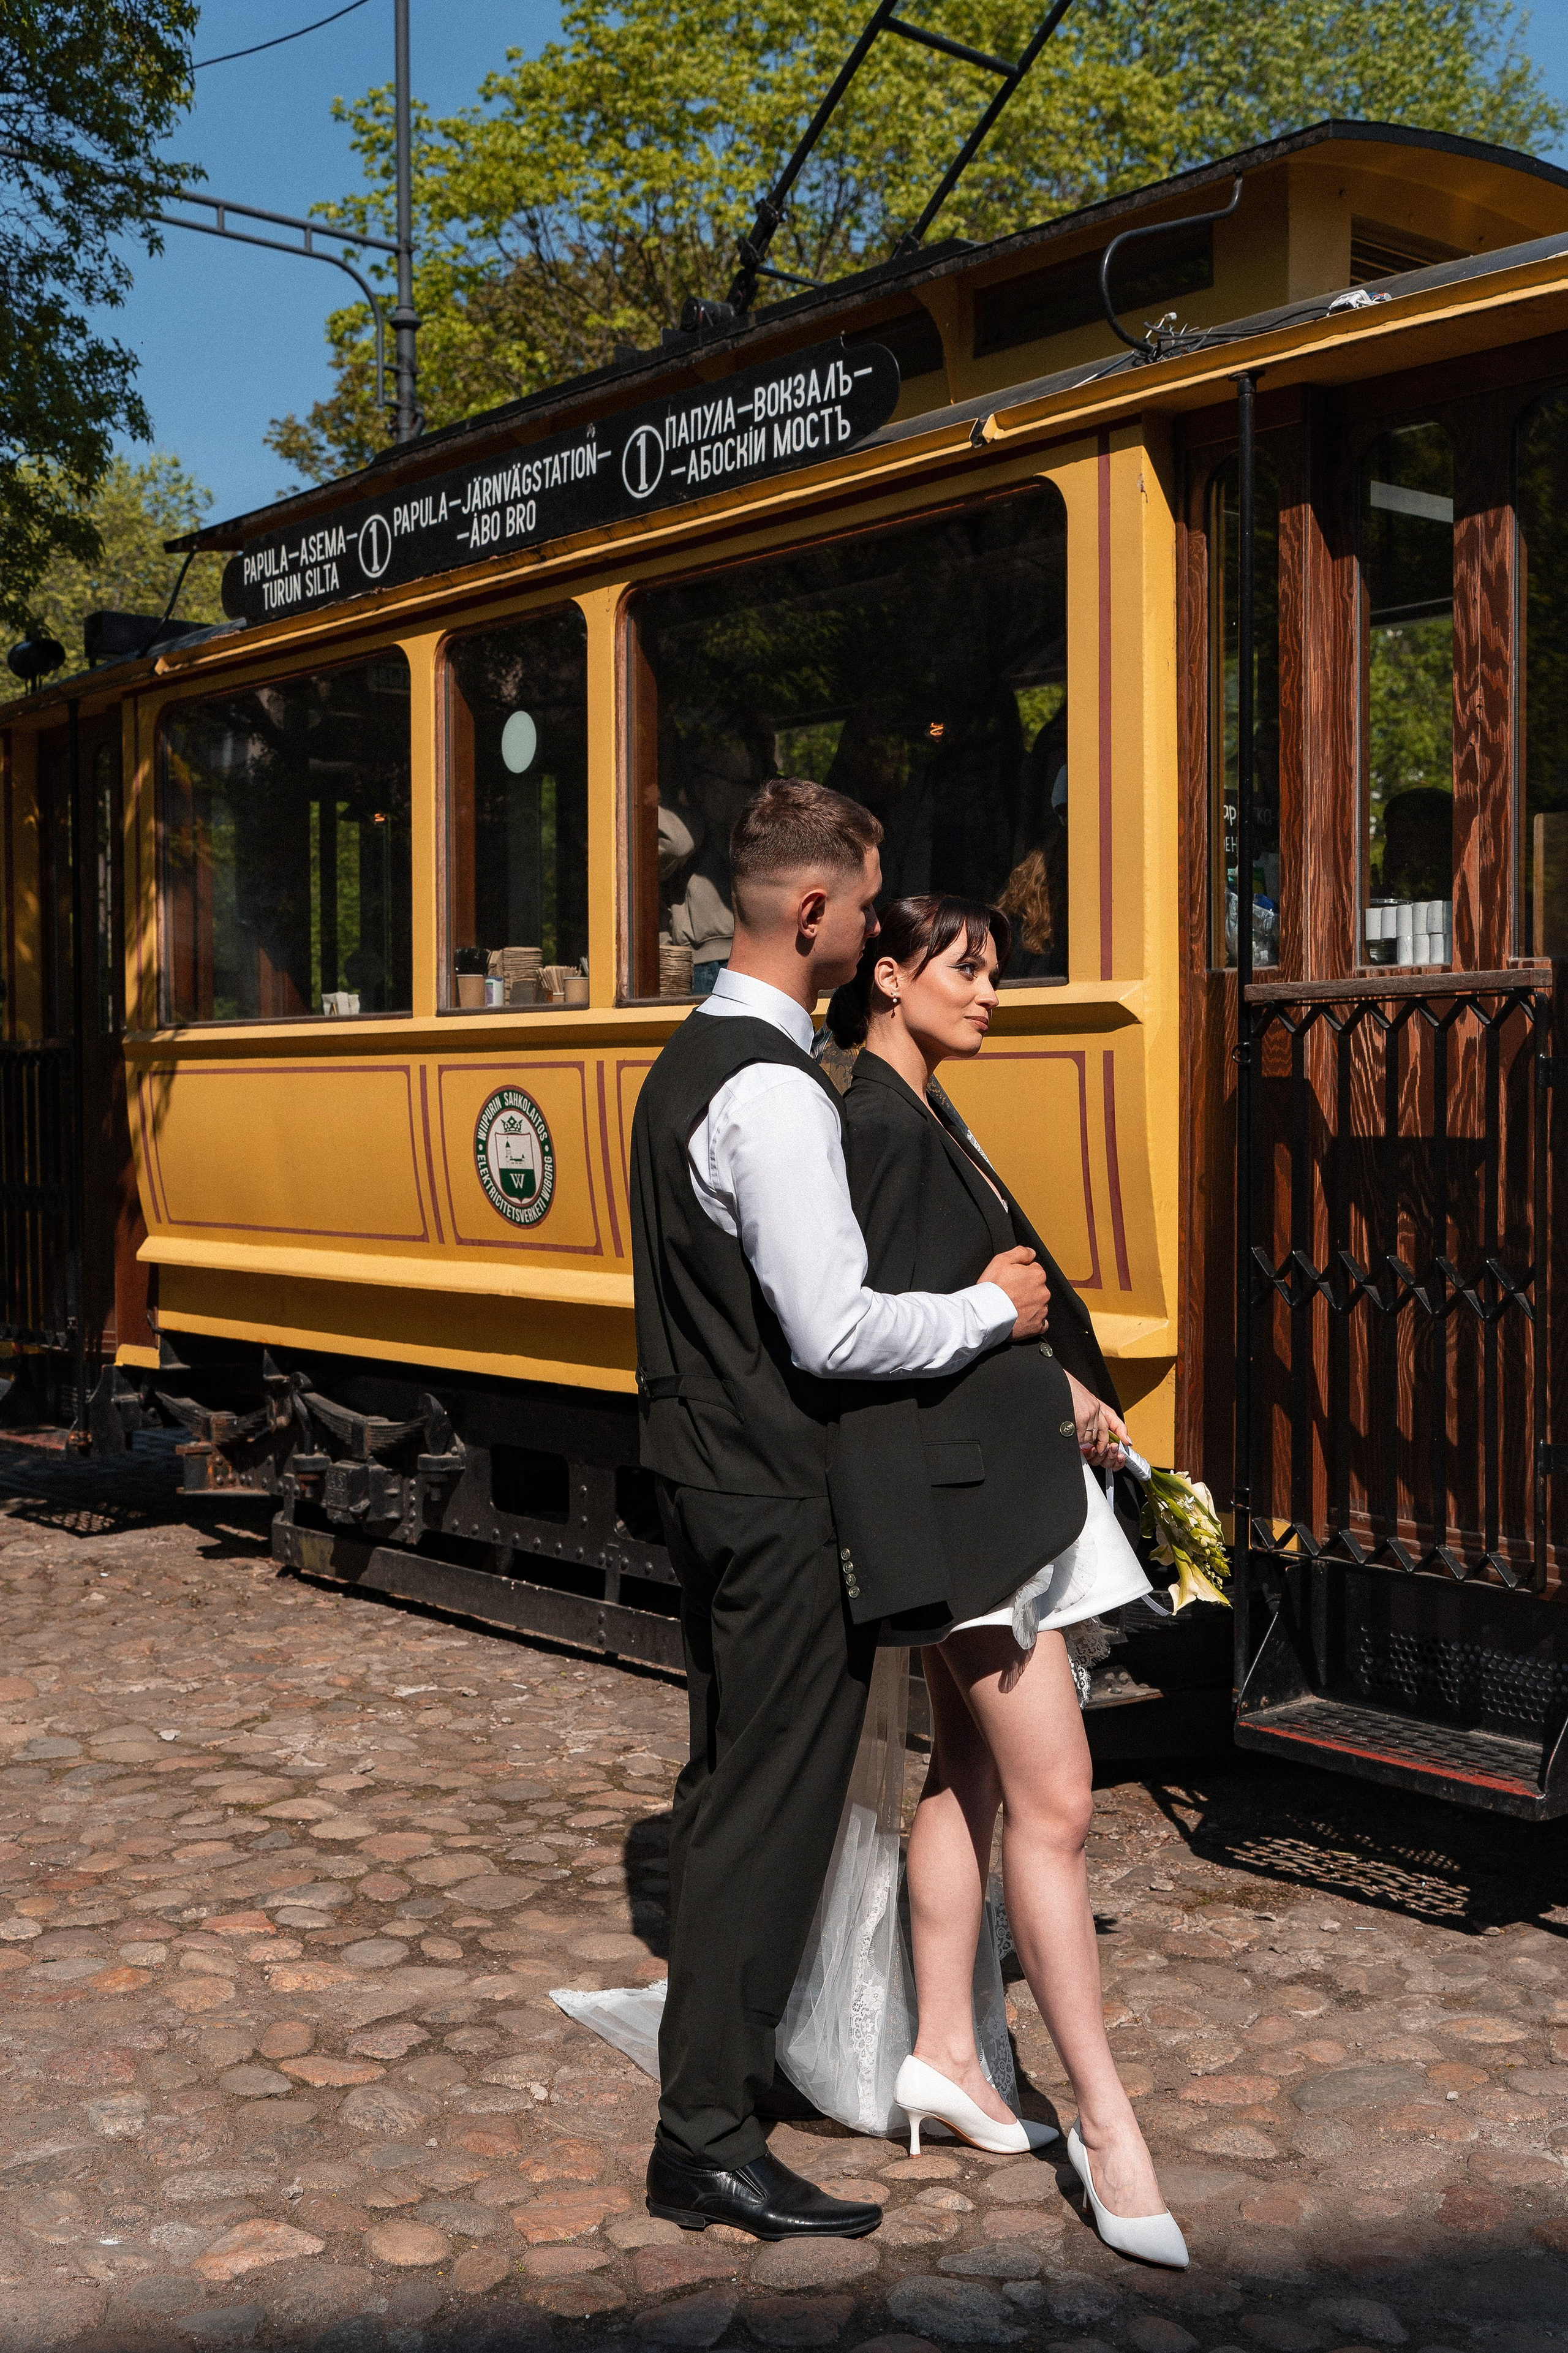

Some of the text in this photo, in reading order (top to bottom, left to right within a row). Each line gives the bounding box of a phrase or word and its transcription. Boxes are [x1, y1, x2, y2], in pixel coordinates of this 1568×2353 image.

[773, 405, 851, 458] МОСТЪ
[506, 500, 536, 538] BRO
[262, 562, 340, 611] TURUN SILTA
[477, 1095, 502, 1141] WIIPURIN
[509, 1173, 526, 1189] W
[540, 1156, 553, 1201] WIBORG
